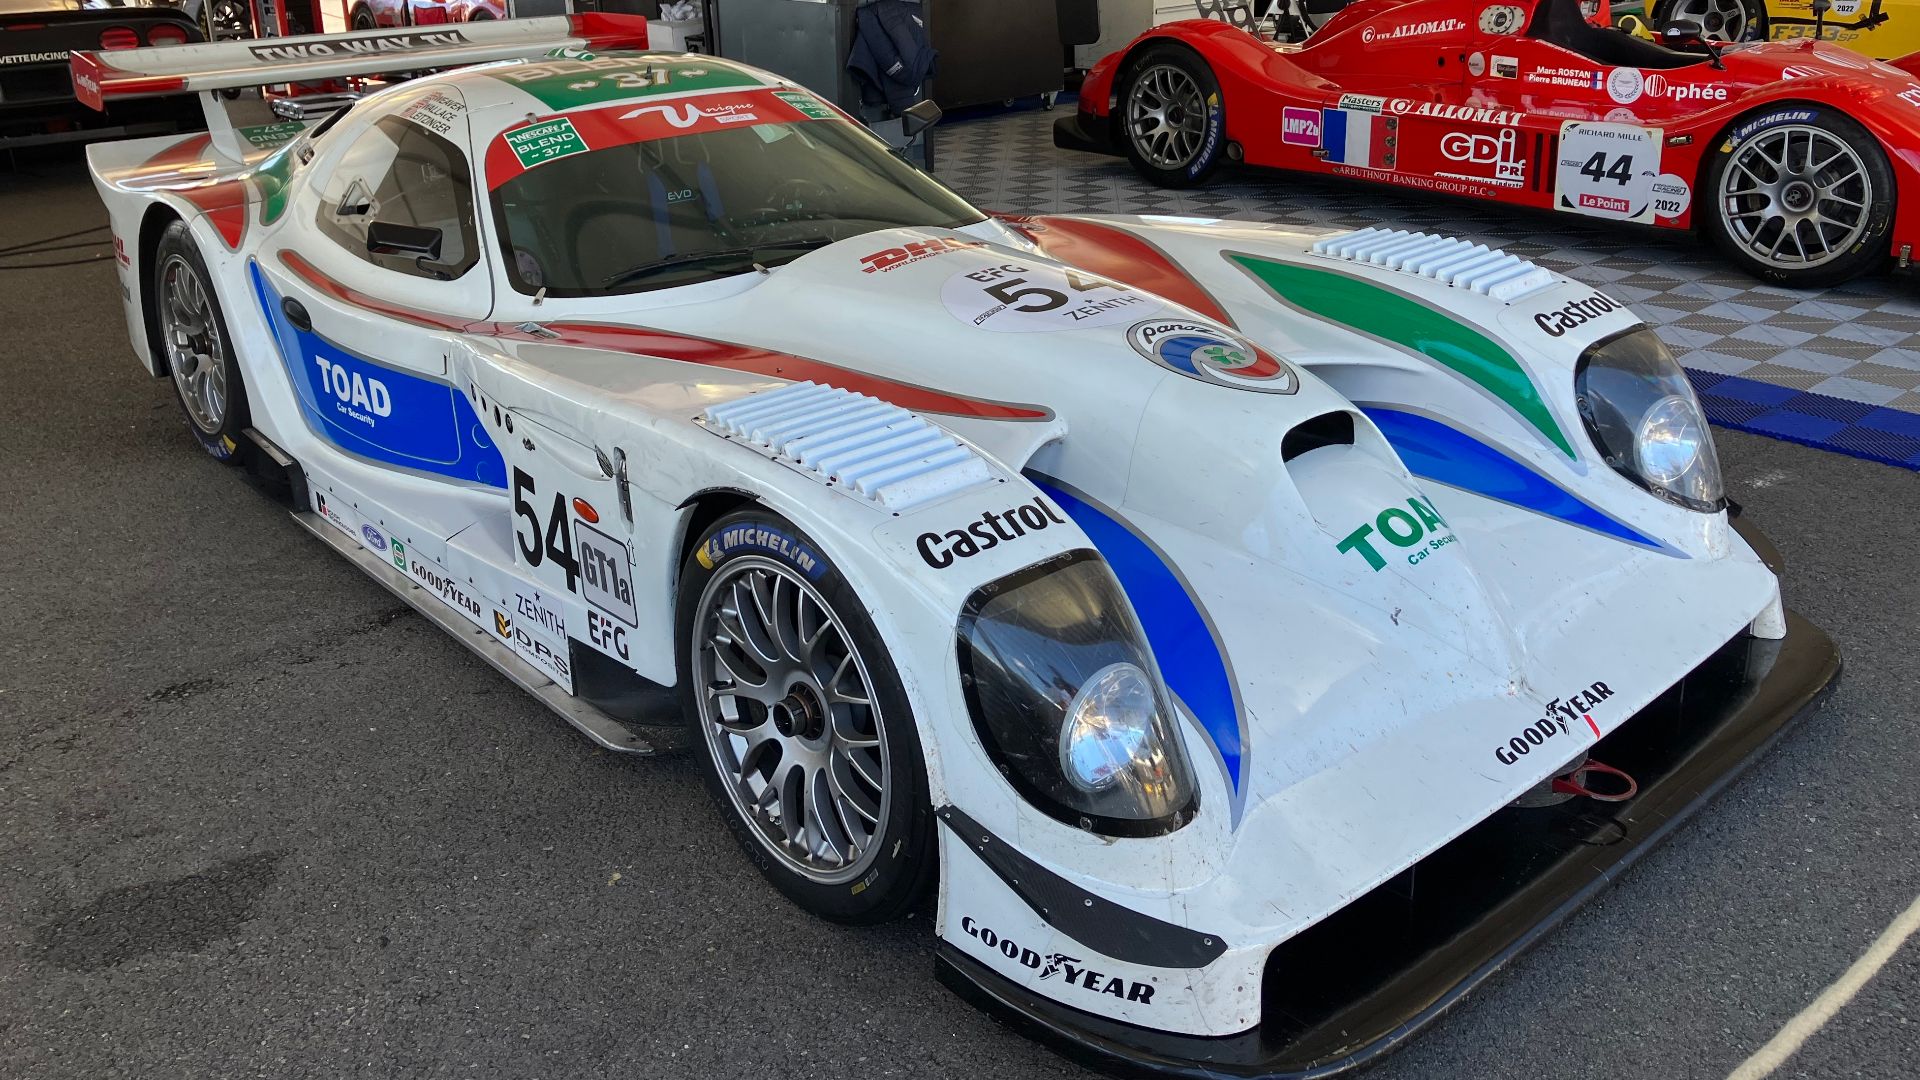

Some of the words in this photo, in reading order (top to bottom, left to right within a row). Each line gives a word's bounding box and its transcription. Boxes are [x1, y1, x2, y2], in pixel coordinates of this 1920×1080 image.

[1376, 19, 1465, 40] www.ALLOMAT.fr
[30, 51, 69, 61] RACING
[255, 43, 335, 62] TWO
[340, 35, 411, 53] WAY
[420, 32, 463, 46] TV
[1528, 74, 1551, 84] Pierre
[1552, 76, 1590, 88] BRUNEAU
[1536, 66, 1556, 75] Marc
[1558, 68, 1591, 79] ROSTAN
[1341, 95, 1381, 106] Masters
[410, 112, 451, 134] LEITZINGER
[1415, 102, 1526, 126] ALLOMAT
[1741, 111, 1812, 137] MICHELIN
[1284, 118, 1319, 136] LMP2b
[1578, 128, 1615, 139] RICHARD
[1618, 130, 1643, 141] MILLE
[517, 132, 576, 154] BLEND
[541, 145, 561, 157] 37
[1190, 121, 1218, 175] MICHELIN
[1580, 151, 1634, 186] 44
[1339, 167, 1391, 183] ARBUTHNOT
[1392, 175, 1434, 189] BANKING
[1435, 180, 1468, 193] GROUP
[1469, 186, 1487, 196] PLC
[668, 189, 692, 201] EVO
[1583, 195, 1596, 205] Le
[1597, 197, 1626, 211] Point
[1655, 199, 1680, 212] 2022
[880, 252, 941, 273] WORLDWIDE
[964, 264, 1030, 283] EFG
[983, 269, 1131, 313] 54
[1063, 294, 1145, 321] ZENITH
[1534, 291, 1622, 337] Castrol
[315, 354, 391, 417] TOAD
[336, 402, 347, 414] Car
[348, 407, 374, 428] Security
[513, 465, 580, 594] 54
[916, 496, 1066, 570] Castrol
[723, 528, 816, 572] MICHELIN
[1408, 547, 1430, 566] Car
[581, 541, 632, 606] GT1a
[515, 593, 567, 640] ZENITH
[587, 609, 630, 661] EFG
[517, 641, 570, 684] COMPOSITES
